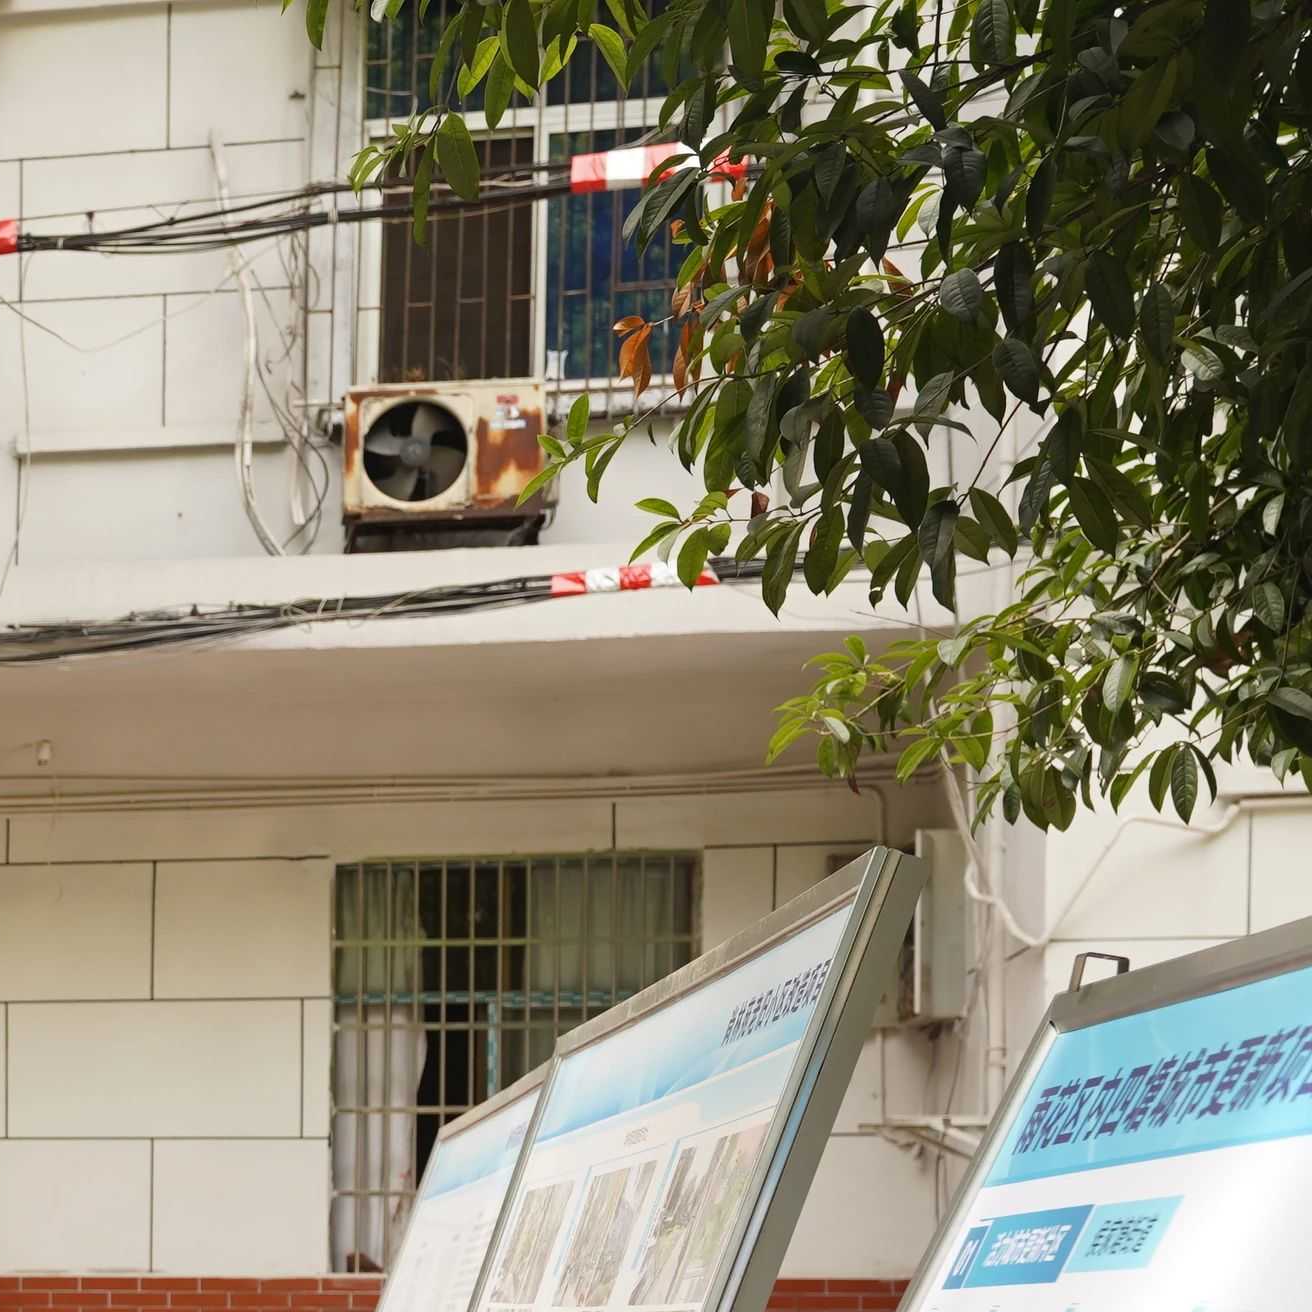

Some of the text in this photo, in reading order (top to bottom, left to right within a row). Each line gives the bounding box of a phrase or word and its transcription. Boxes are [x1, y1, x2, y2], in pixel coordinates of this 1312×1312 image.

[1013, 1025, 1312, 1155] 雨花区内四塘城市更新项
